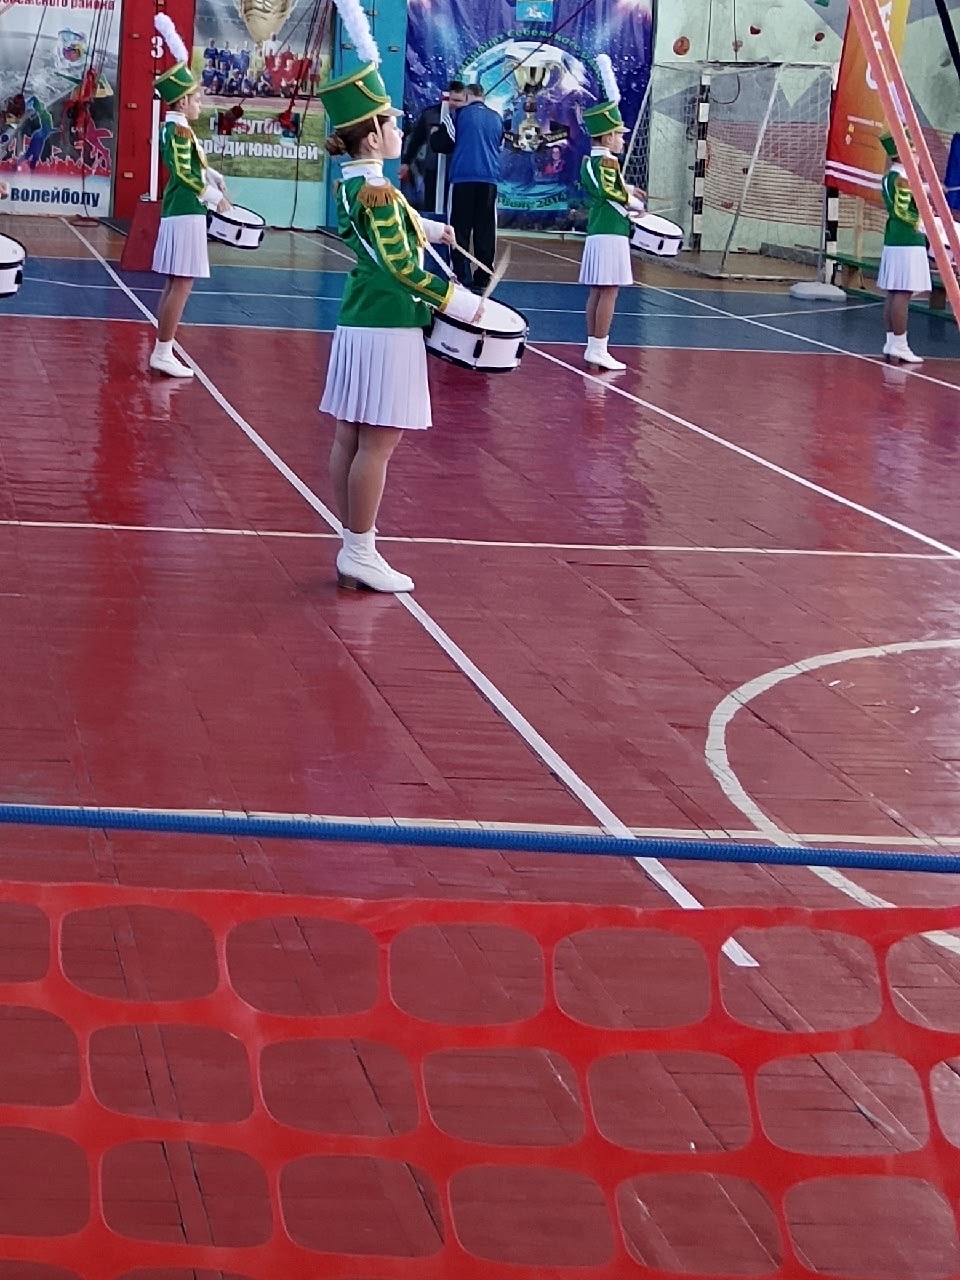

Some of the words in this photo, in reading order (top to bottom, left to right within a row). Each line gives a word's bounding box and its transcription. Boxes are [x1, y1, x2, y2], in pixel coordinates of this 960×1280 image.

[150, 36, 164, 59] 3
[248, 142, 319, 161] юношей
[10, 186, 100, 208] волейболу
